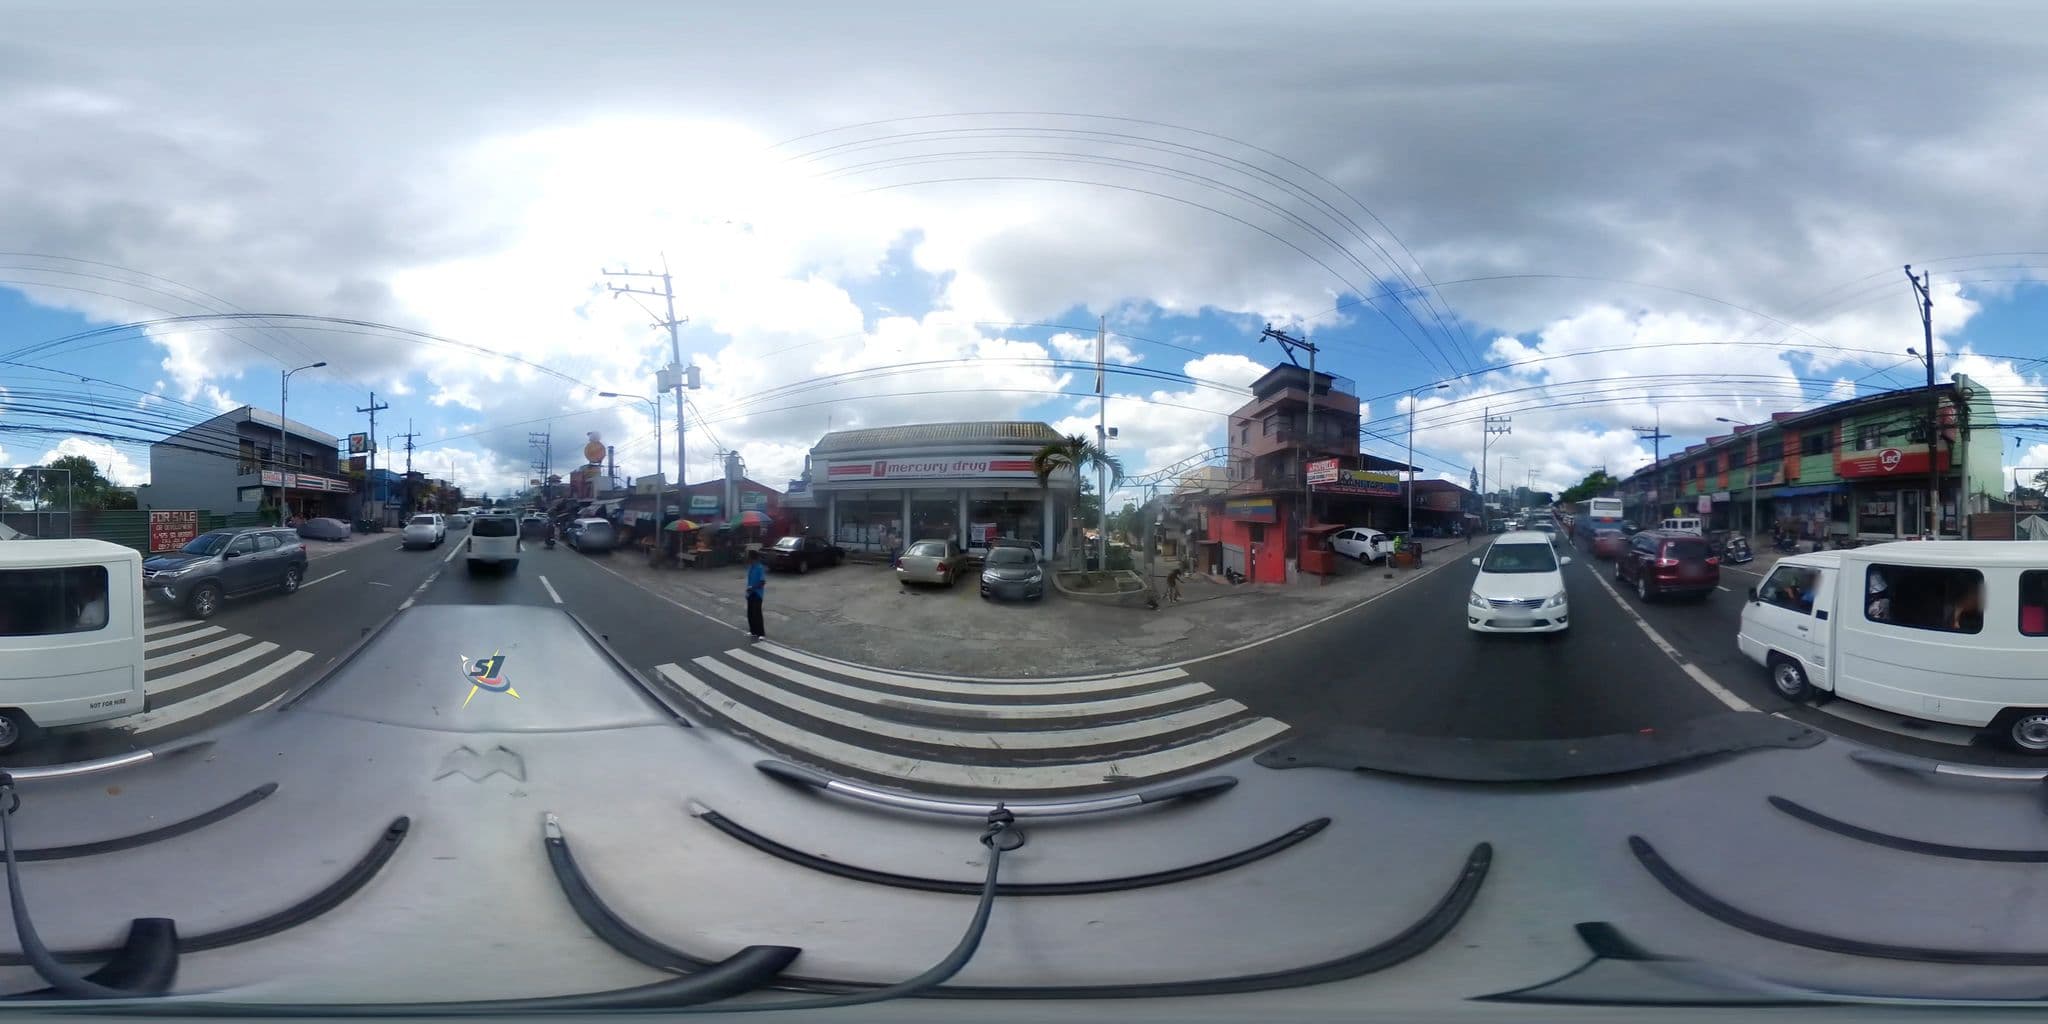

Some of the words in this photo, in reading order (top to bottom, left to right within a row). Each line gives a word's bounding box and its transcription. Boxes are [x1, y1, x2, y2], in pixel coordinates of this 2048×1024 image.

[888, 463, 948, 473] mercury
[952, 461, 986, 473] drug
[151, 512, 170, 522] FOR
[172, 511, 196, 521] SALE
